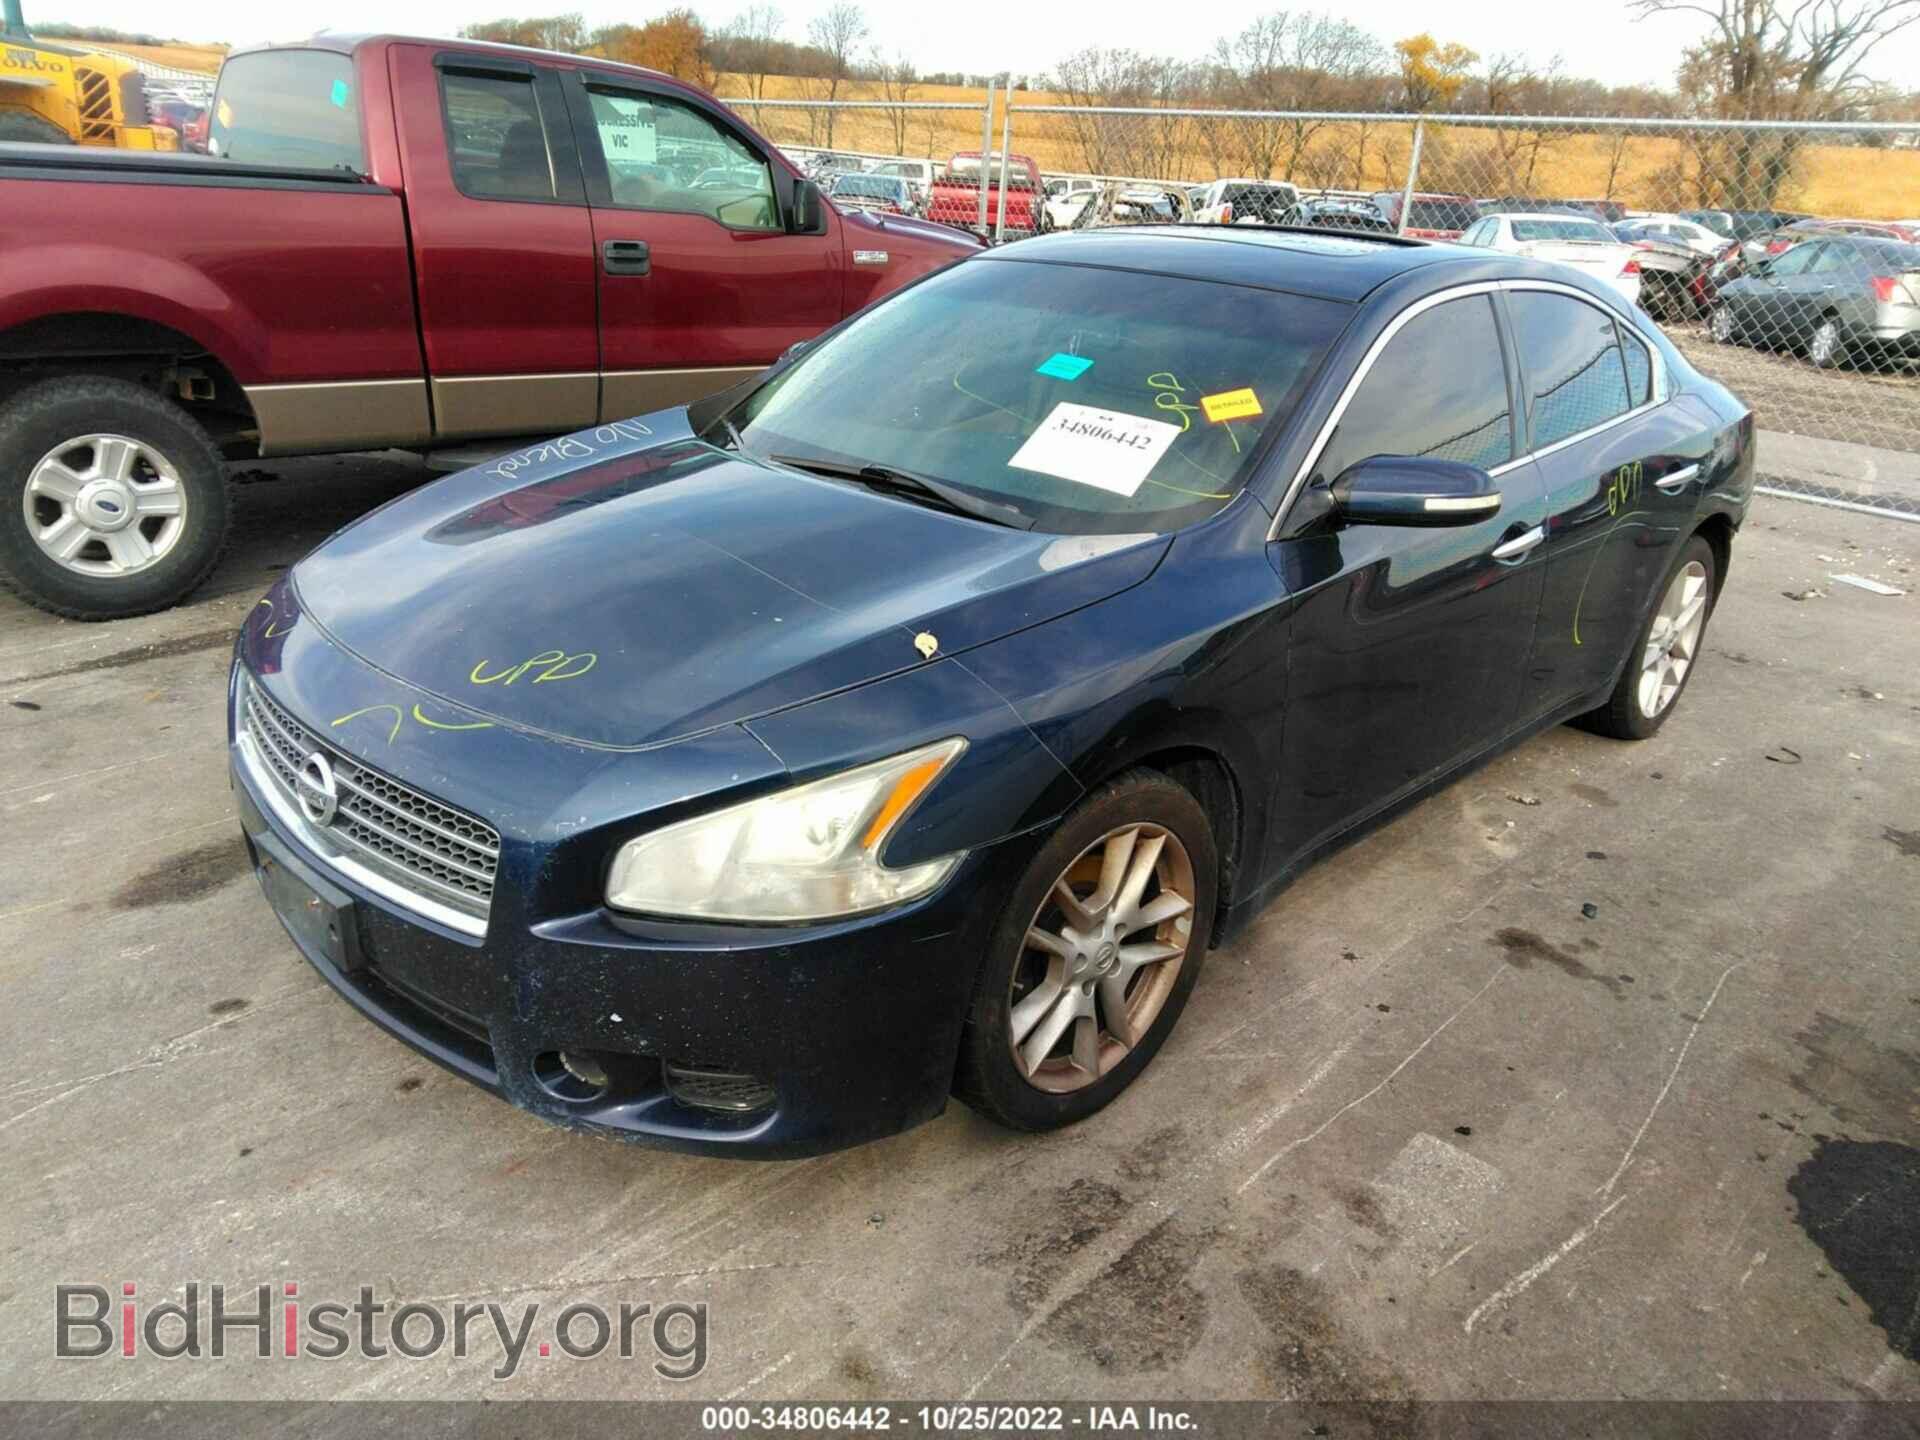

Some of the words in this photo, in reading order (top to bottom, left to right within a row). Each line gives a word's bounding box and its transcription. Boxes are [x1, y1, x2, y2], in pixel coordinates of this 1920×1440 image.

[612, 134, 629, 148] VIC
[595, 419, 653, 443] No
[1059, 418, 1152, 450] 34806442
[486, 437, 596, 479] Blend
[470, 650, 597, 685] UPD
